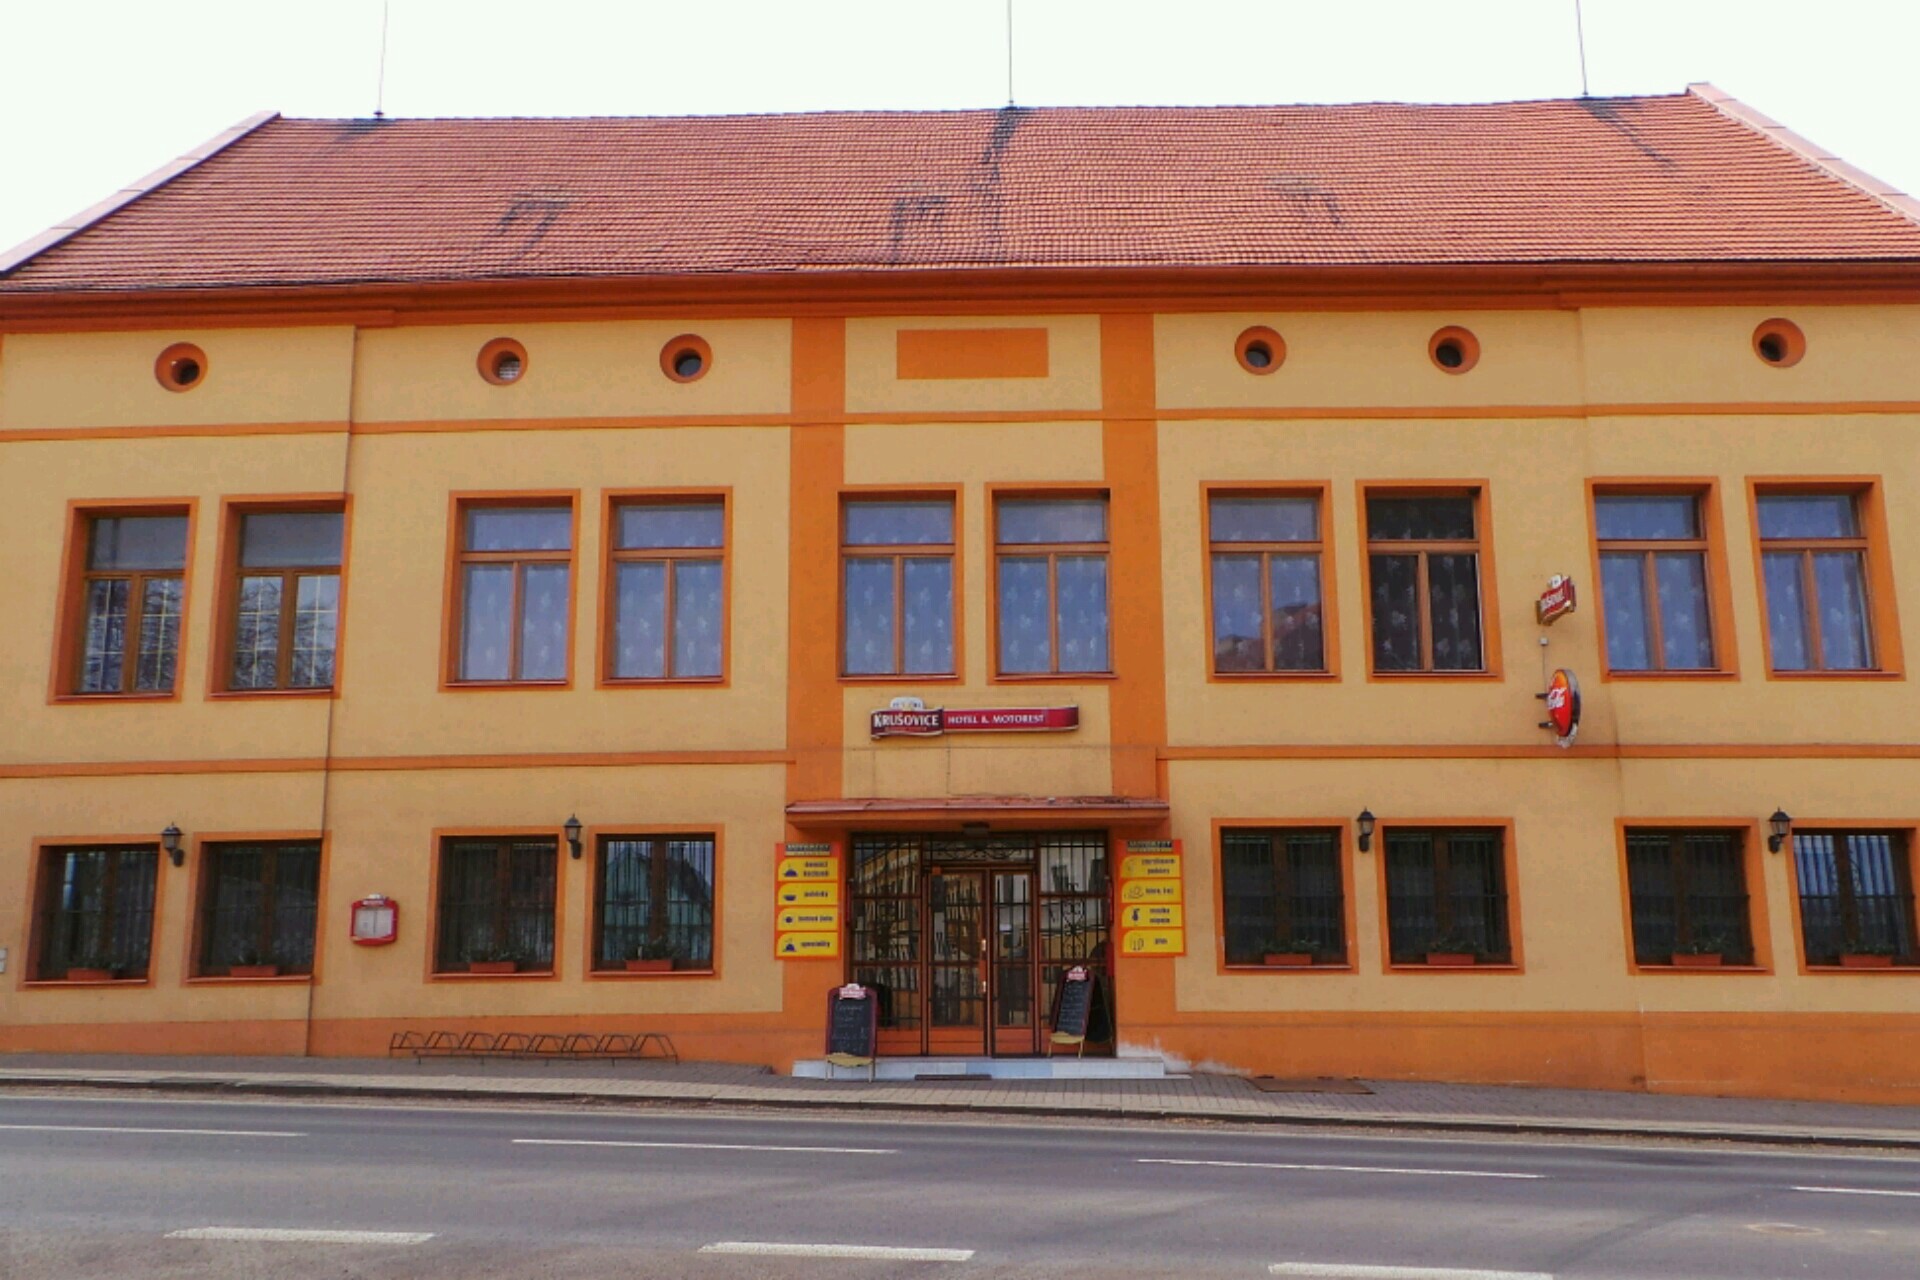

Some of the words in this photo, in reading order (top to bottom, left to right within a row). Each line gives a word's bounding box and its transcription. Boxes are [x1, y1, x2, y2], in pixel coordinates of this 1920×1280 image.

[874, 713, 939, 727] KRUŠOVICE
[947, 714, 978, 724] HOTEL
[981, 714, 989, 724] &
[992, 713, 1045, 724] MOTOREST
